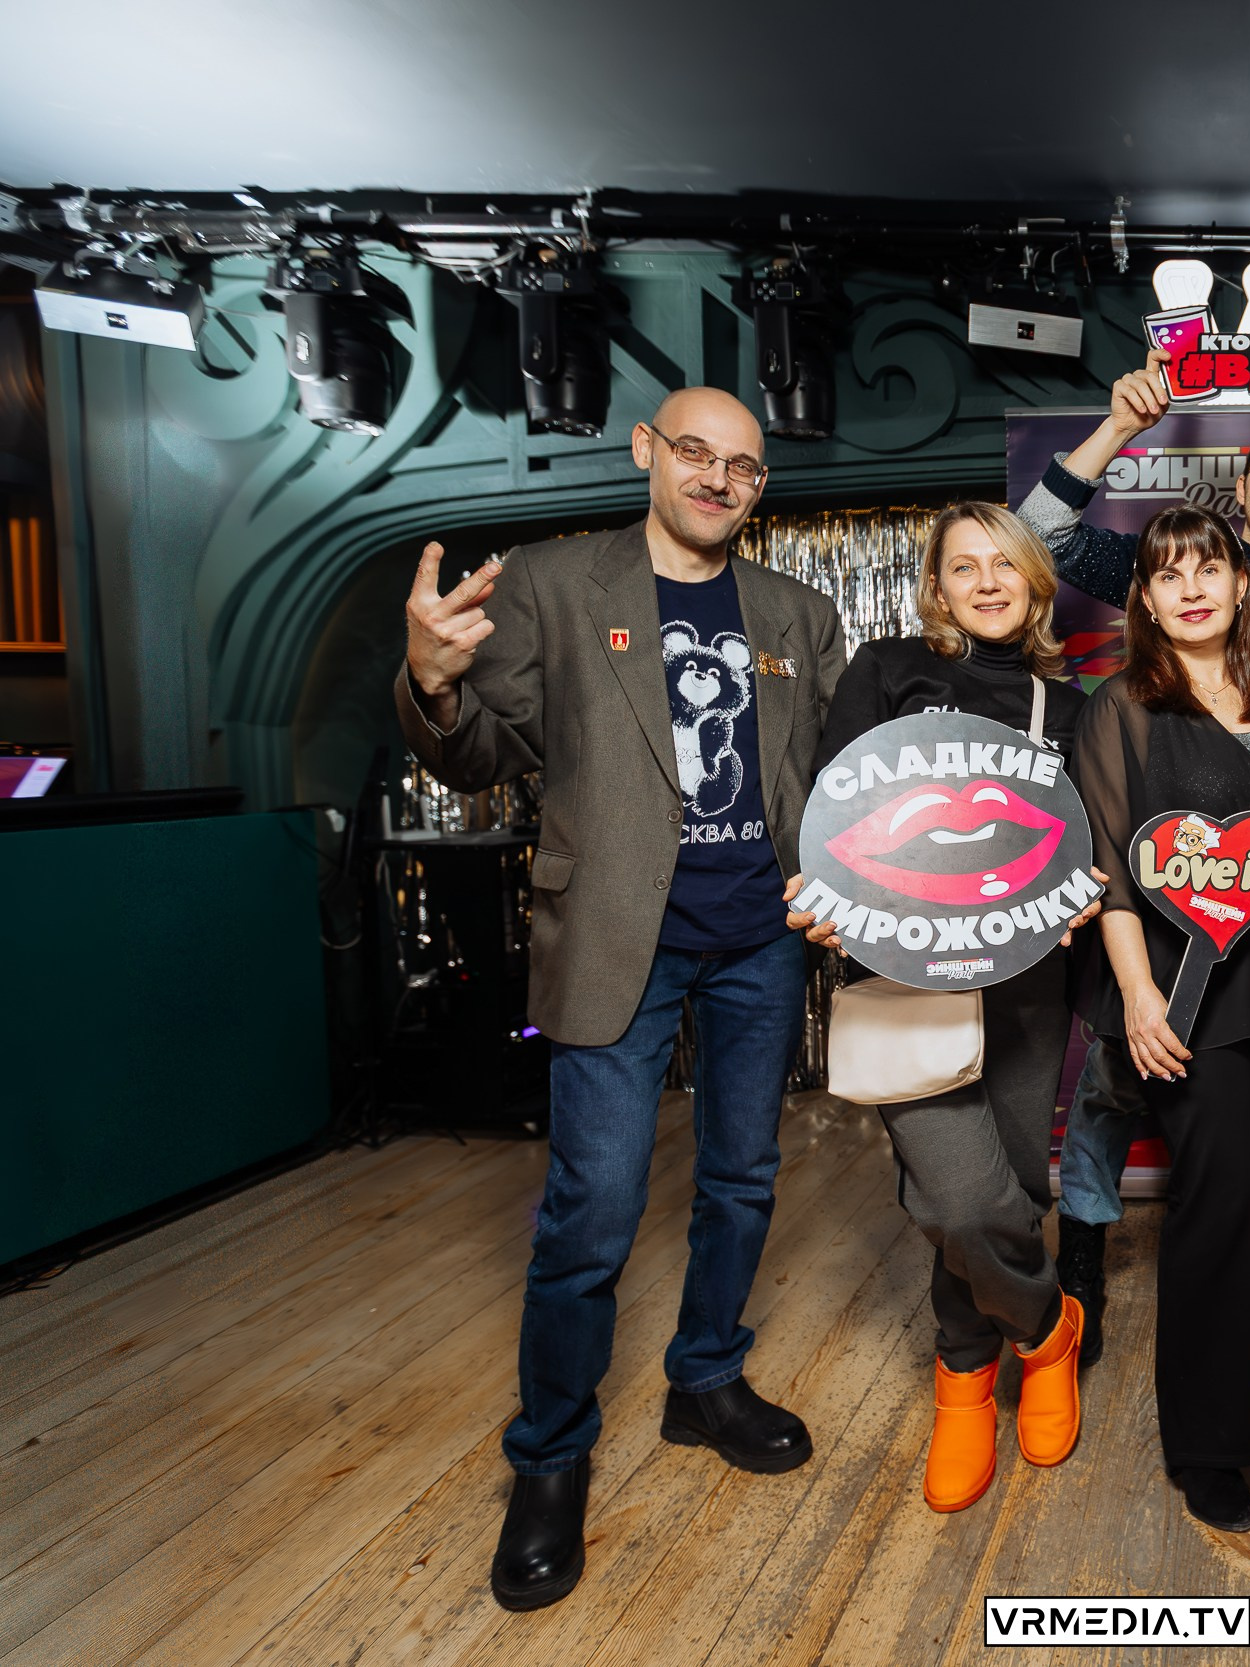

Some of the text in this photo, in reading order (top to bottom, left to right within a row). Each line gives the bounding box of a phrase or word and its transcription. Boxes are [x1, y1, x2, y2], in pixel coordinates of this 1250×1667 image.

[1201, 335, 1250, 351] КТО
[822, 742, 1061, 801] СЛАДКИЕ
[680, 820, 764, 844] СКВА 80
[1139, 839, 1239, 892] Love
[793, 868, 1101, 952] ПИРОЖОЧКИ
